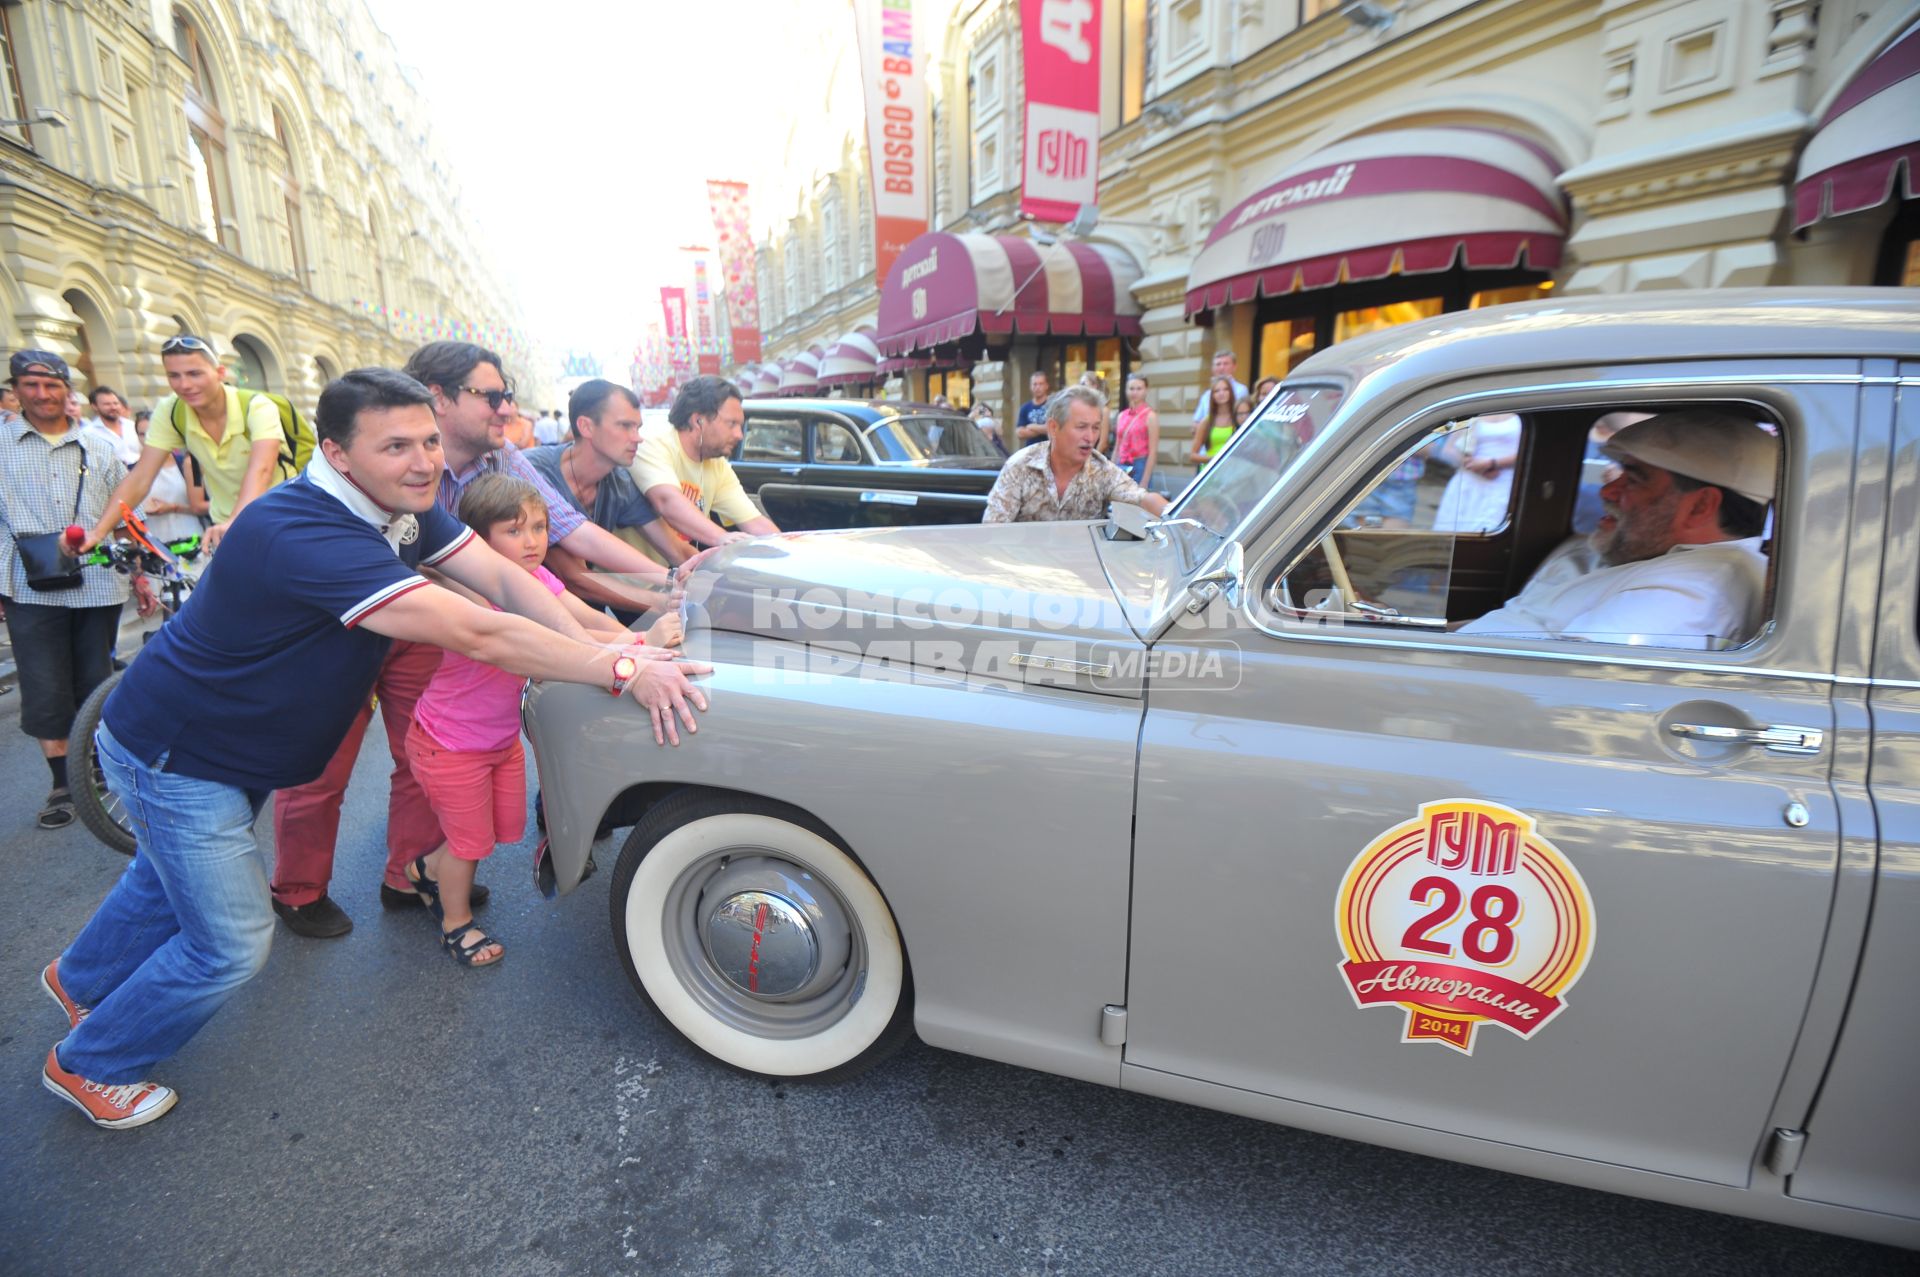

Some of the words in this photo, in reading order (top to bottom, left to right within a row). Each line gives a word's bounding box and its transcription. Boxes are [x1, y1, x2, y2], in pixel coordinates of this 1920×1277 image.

[883, 104, 915, 196] BOSCO
[1401, 876, 1523, 967] 28
[1356, 964, 1541, 1021] Авторалли
[1419, 1018, 1462, 1036] 2014
